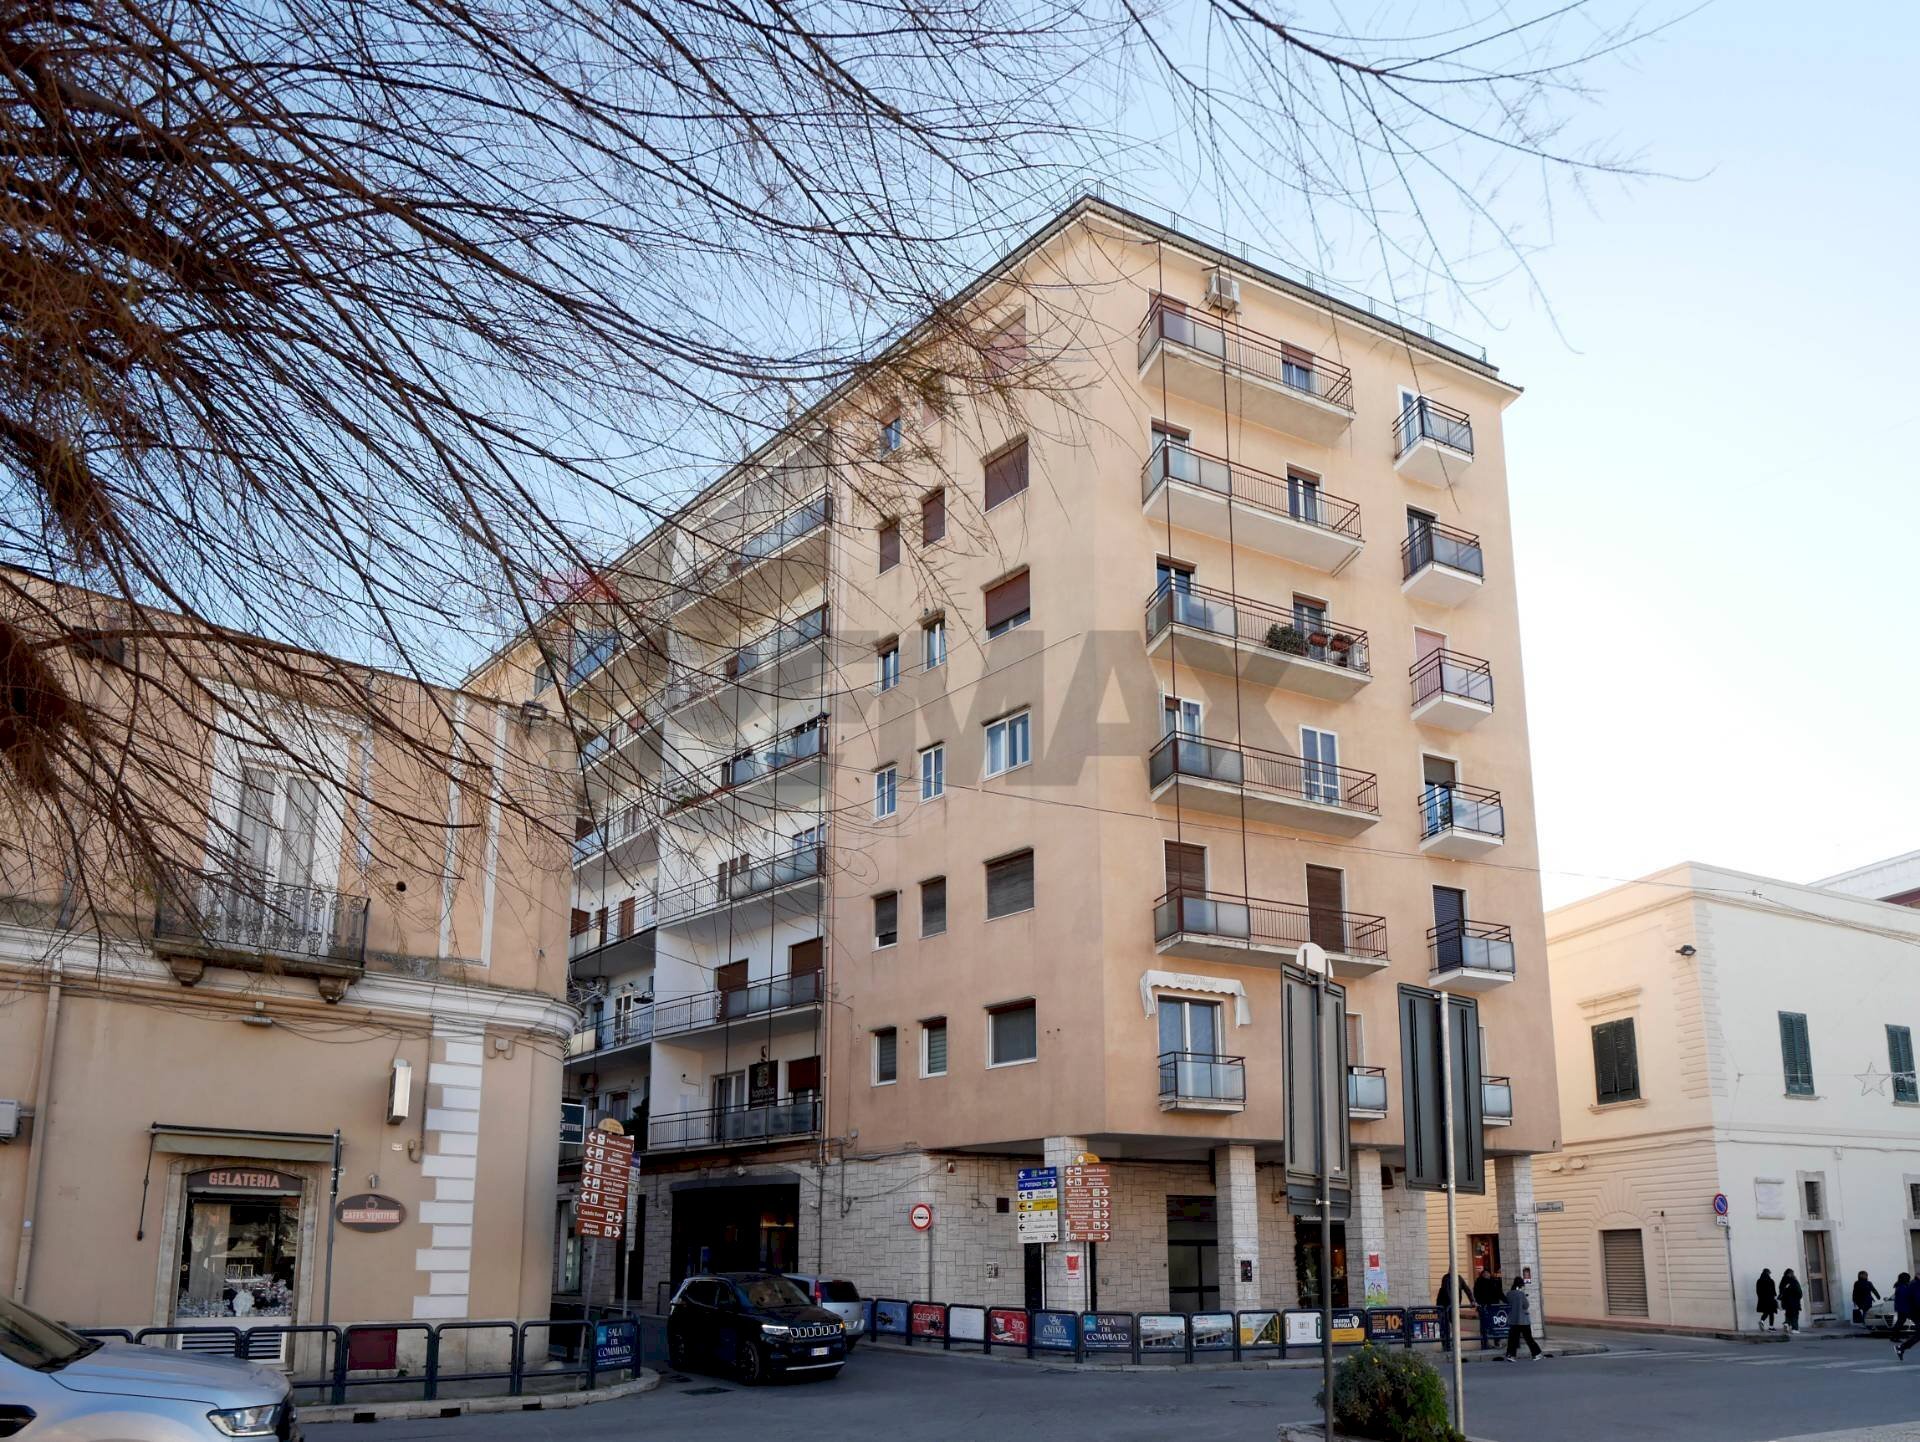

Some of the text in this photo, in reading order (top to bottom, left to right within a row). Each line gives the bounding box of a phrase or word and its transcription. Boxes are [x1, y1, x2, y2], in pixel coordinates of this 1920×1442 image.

[208, 1172, 280, 1188] GELATERIA
[1097, 1318, 1116, 1326] SALA
[608, 1328, 622, 1337] SALA
[1042, 1326, 1067, 1335] ANIMA
[1086, 1333, 1128, 1341] COMMIATO
[598, 1346, 631, 1357] COMMIATO
